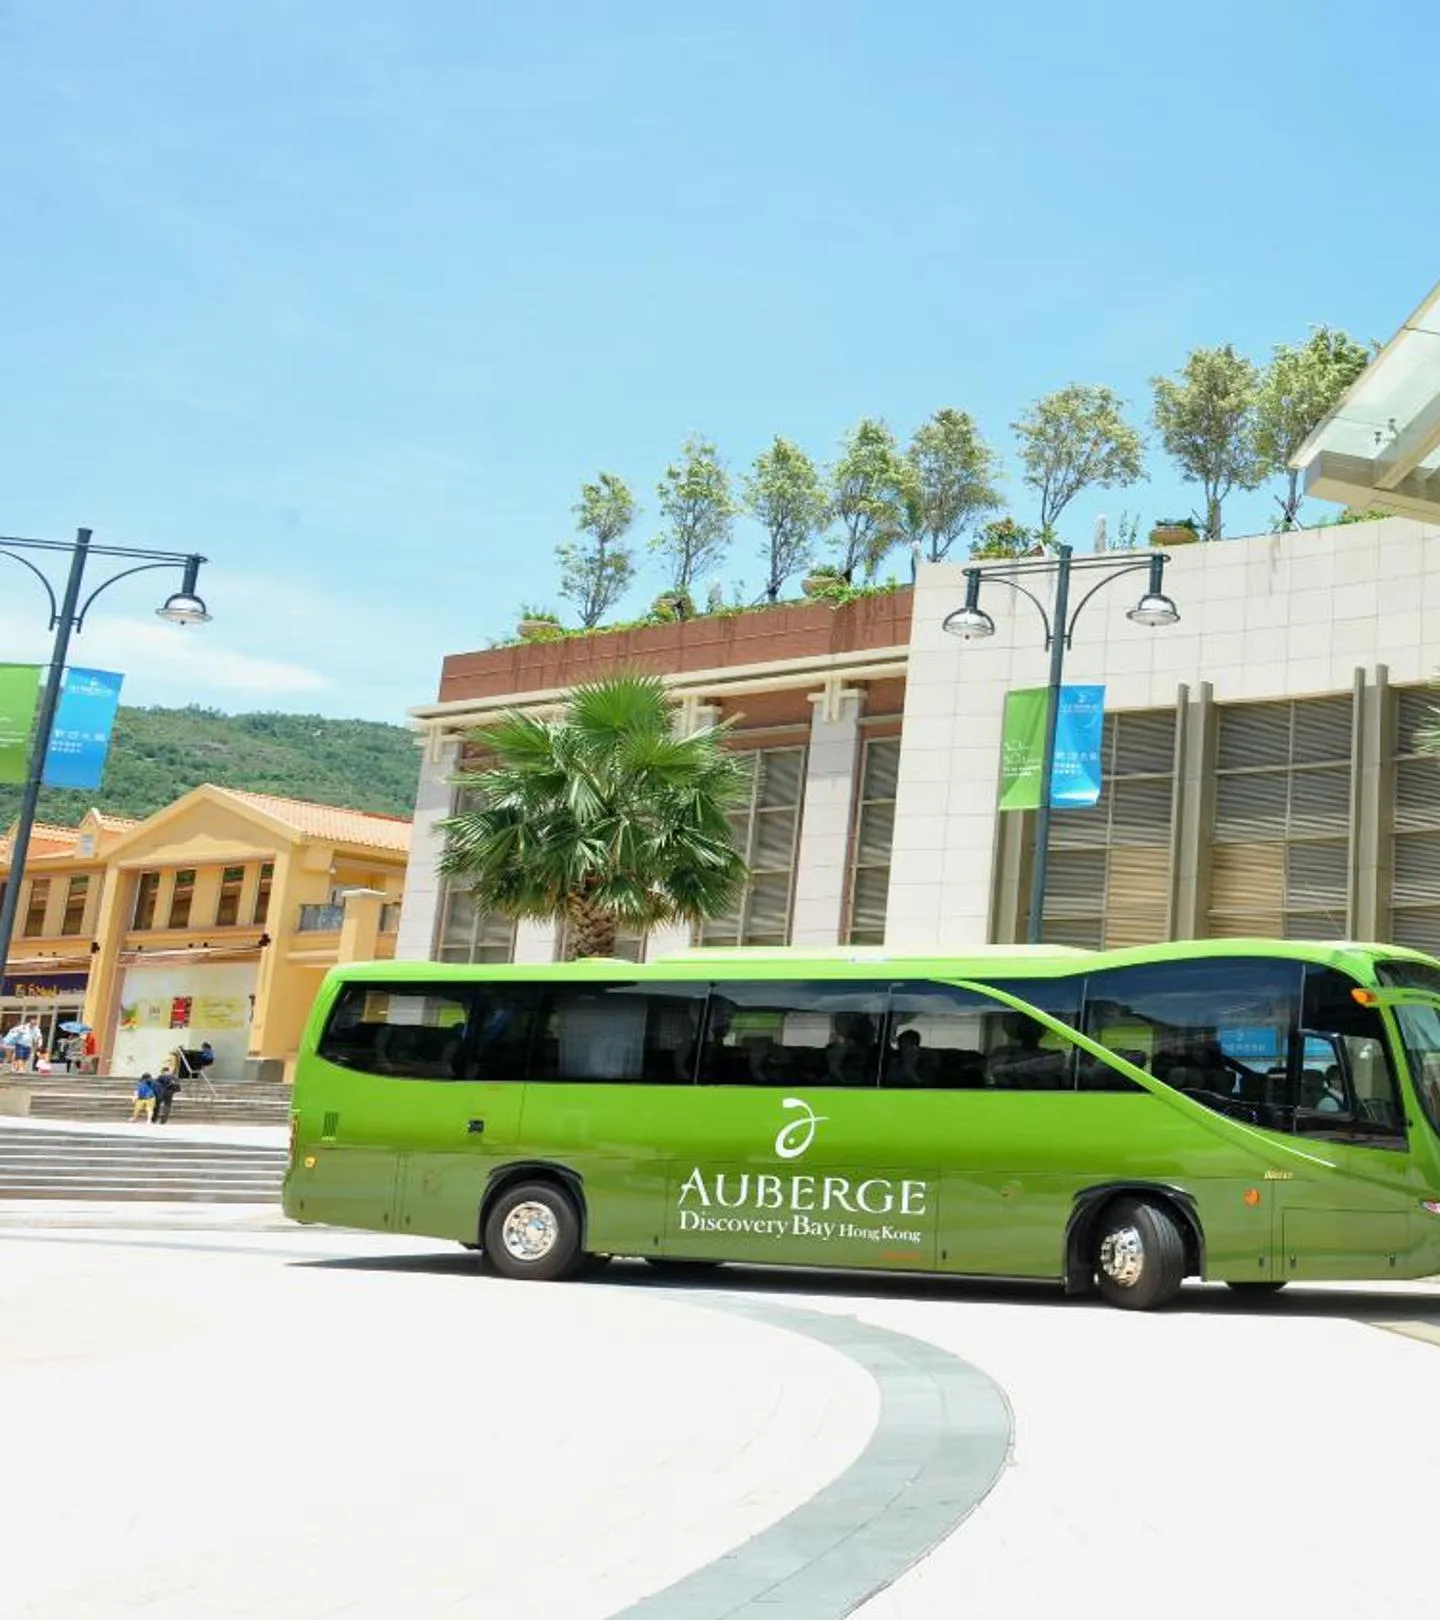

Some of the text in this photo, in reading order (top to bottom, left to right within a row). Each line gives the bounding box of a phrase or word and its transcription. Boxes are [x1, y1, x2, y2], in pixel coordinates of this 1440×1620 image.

[677, 1167, 926, 1215] AUBERGE
[680, 1210, 788, 1238] Discovery
[792, 1215, 835, 1241] Bay
